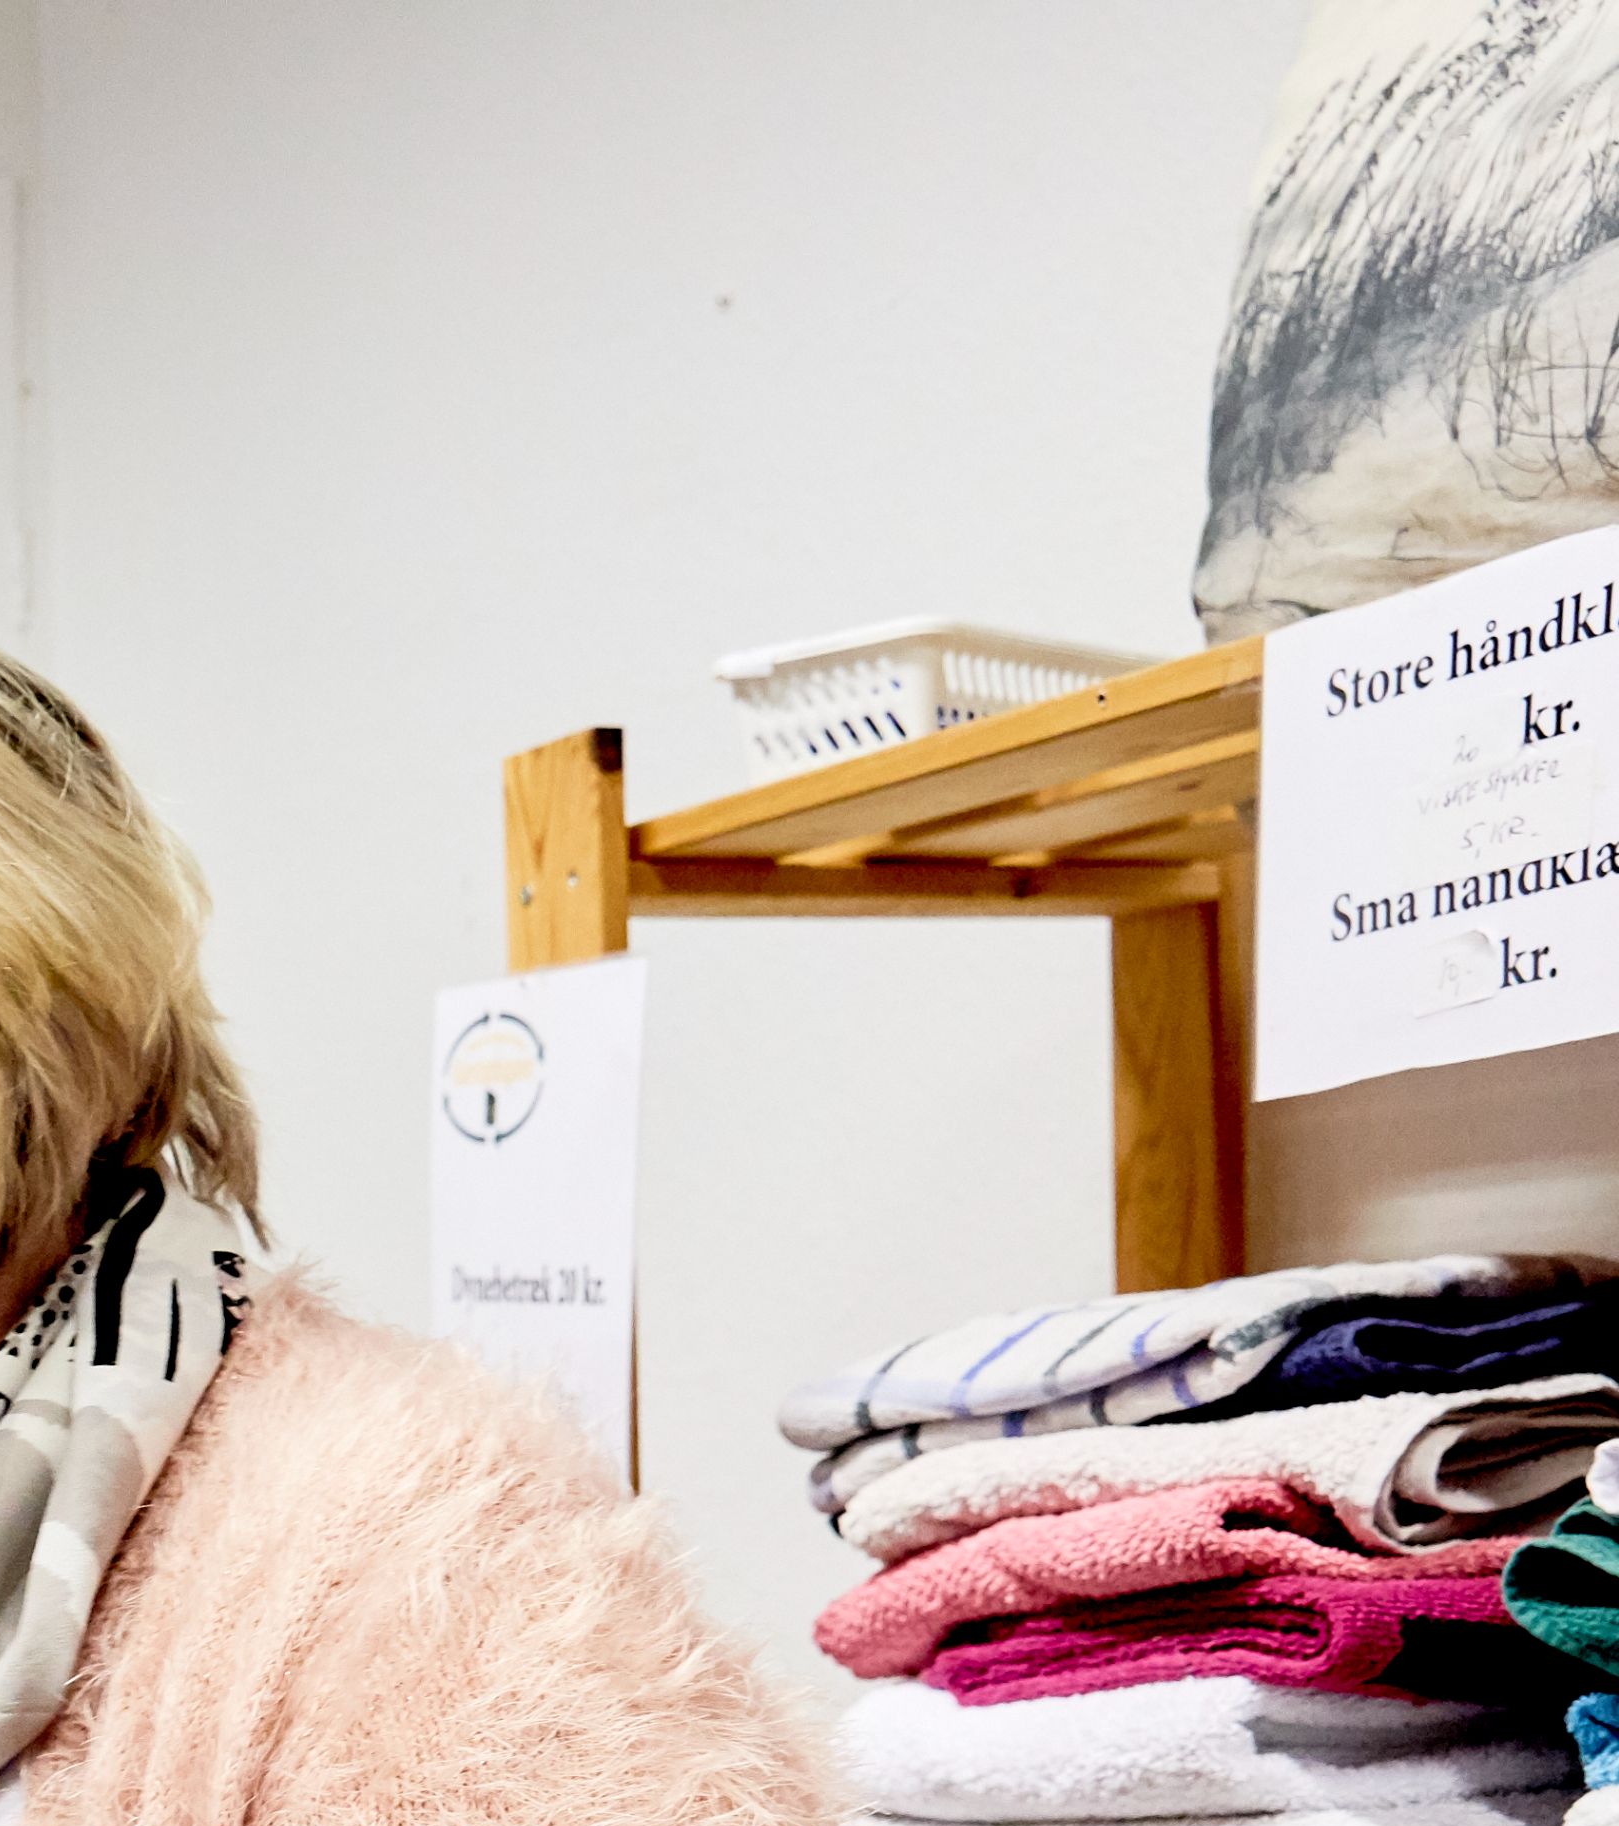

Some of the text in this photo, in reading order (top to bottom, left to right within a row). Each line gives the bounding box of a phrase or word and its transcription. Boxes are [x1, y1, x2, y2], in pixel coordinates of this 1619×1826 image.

[1327, 582, 1619, 717] Store håndkl
[1523, 694, 1581, 746] kr.
[1500, 937, 1558, 989] kr.
